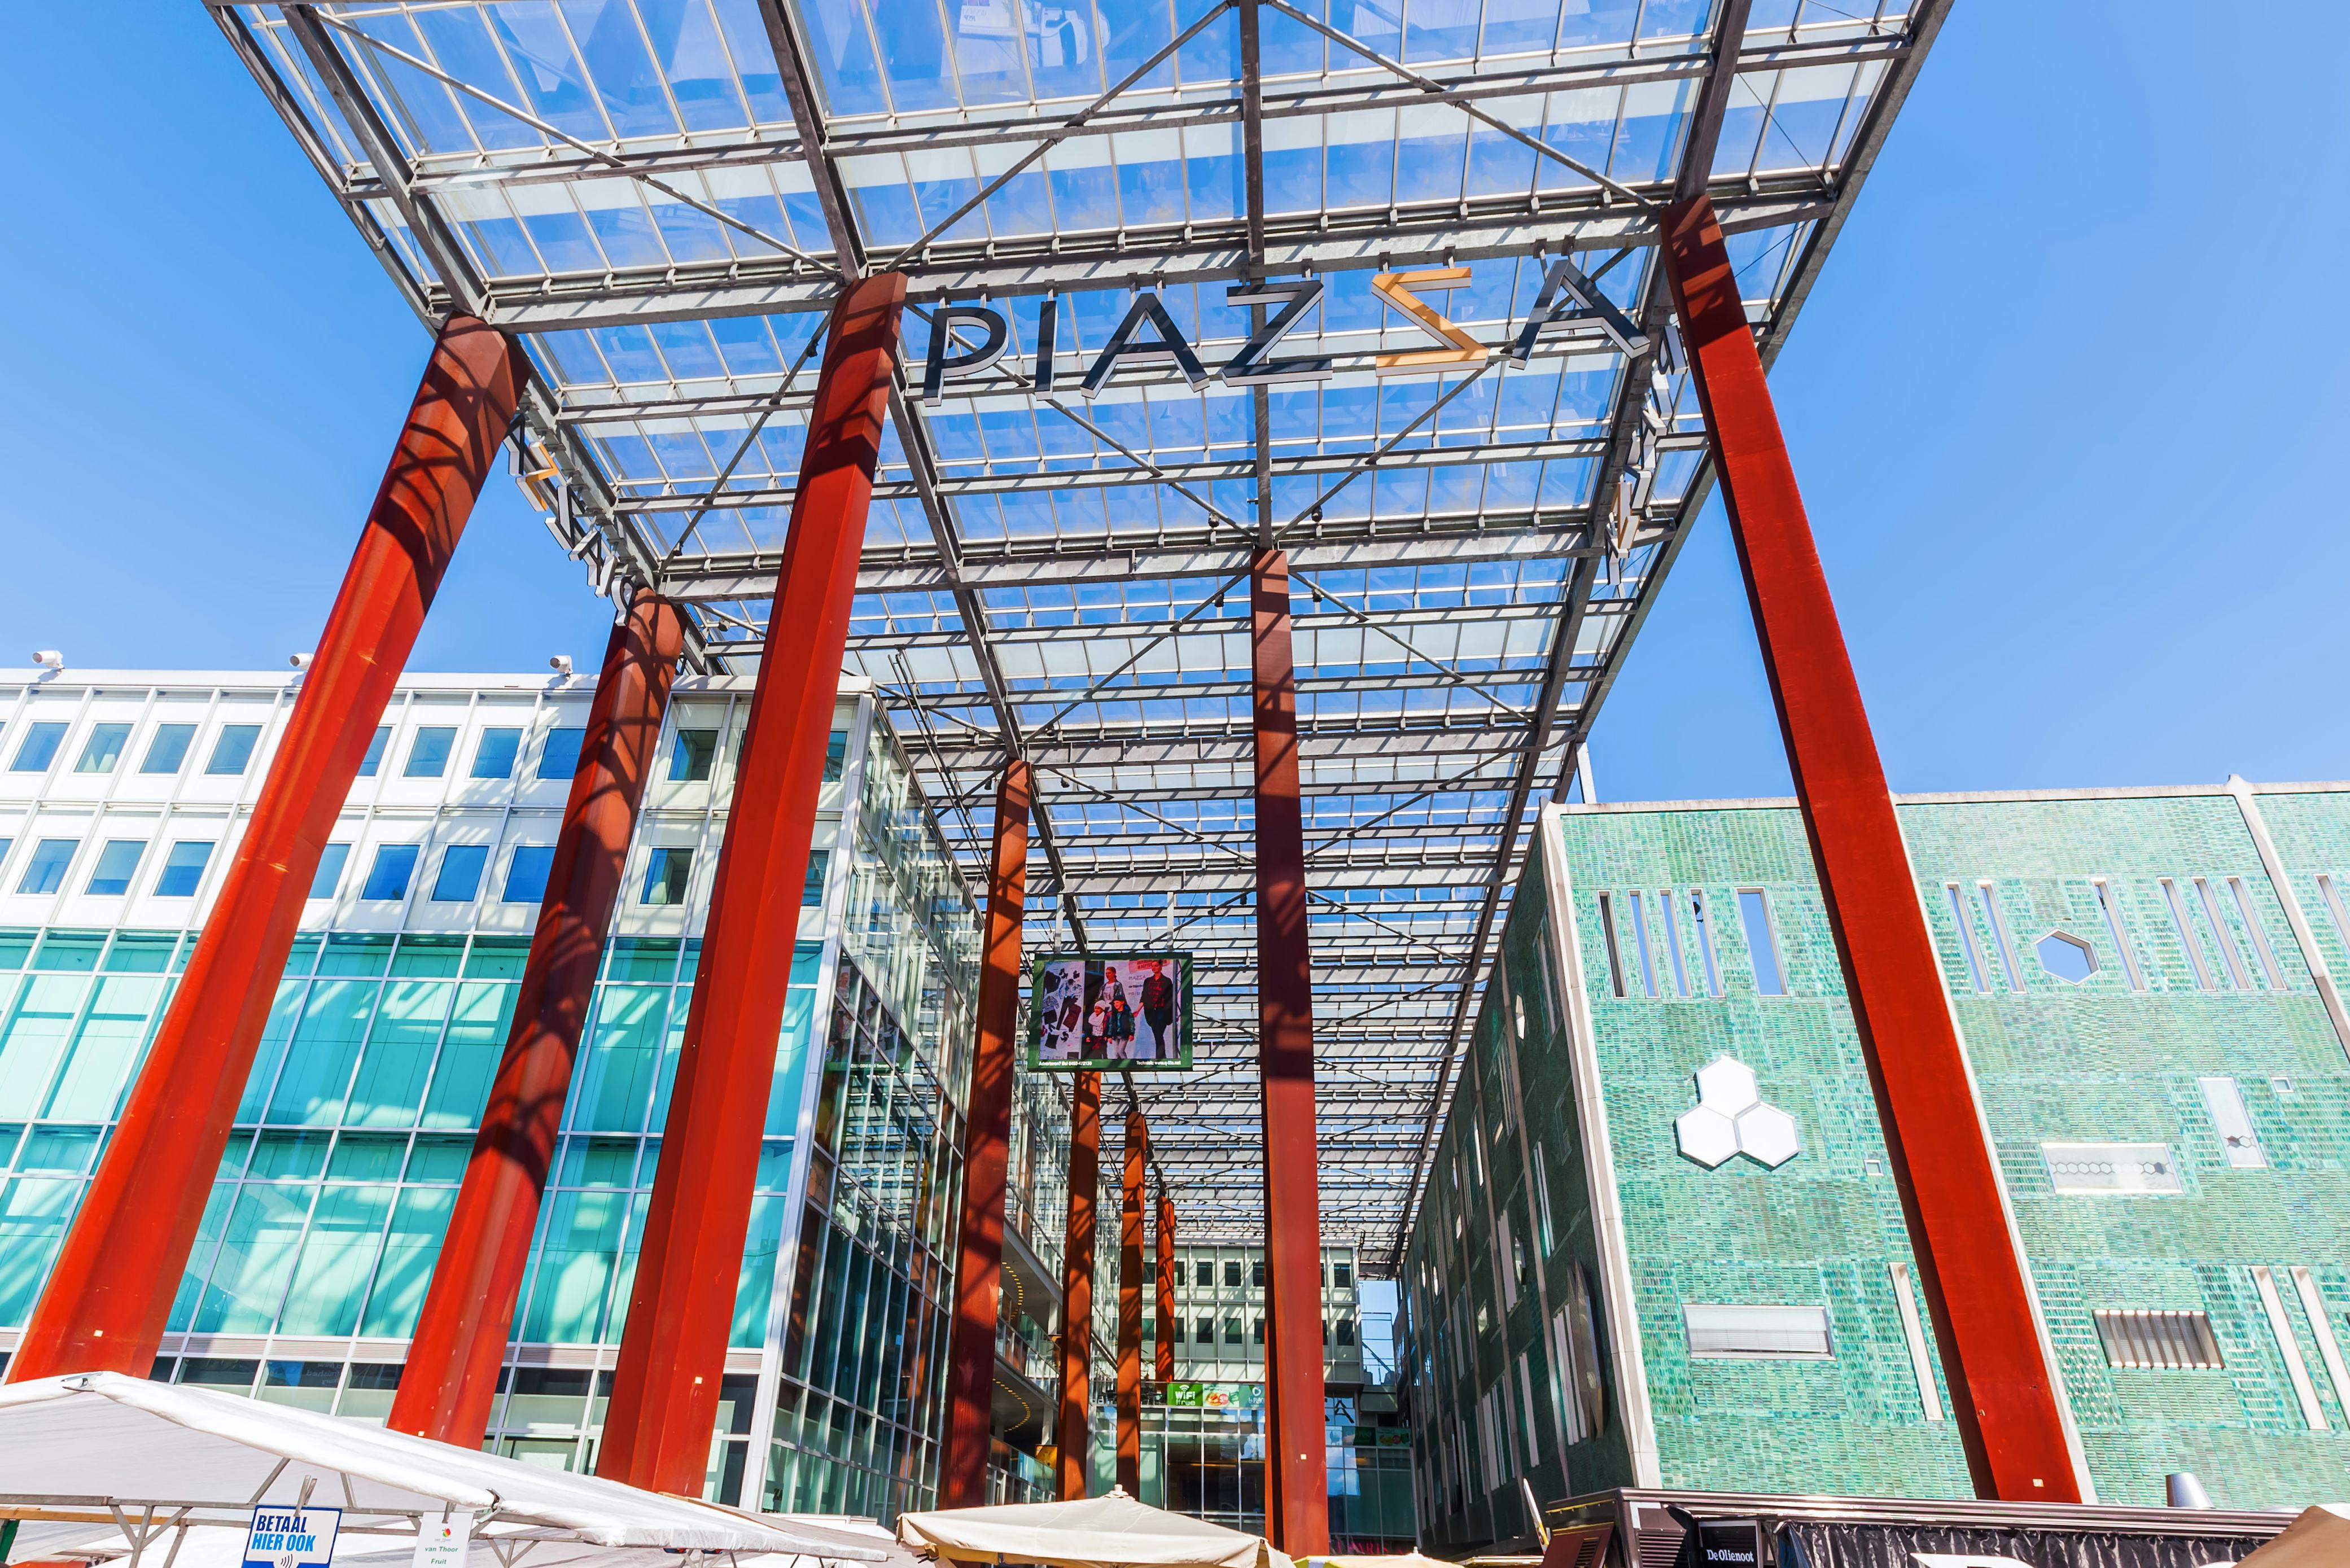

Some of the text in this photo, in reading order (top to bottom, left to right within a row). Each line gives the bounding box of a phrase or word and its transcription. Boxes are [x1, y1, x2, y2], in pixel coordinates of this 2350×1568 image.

[256, 1515, 307, 1533] BETAAL
[251, 1534, 316, 1552] HIER OOK
[1706, 1549, 1754, 1562] De Olienoot
